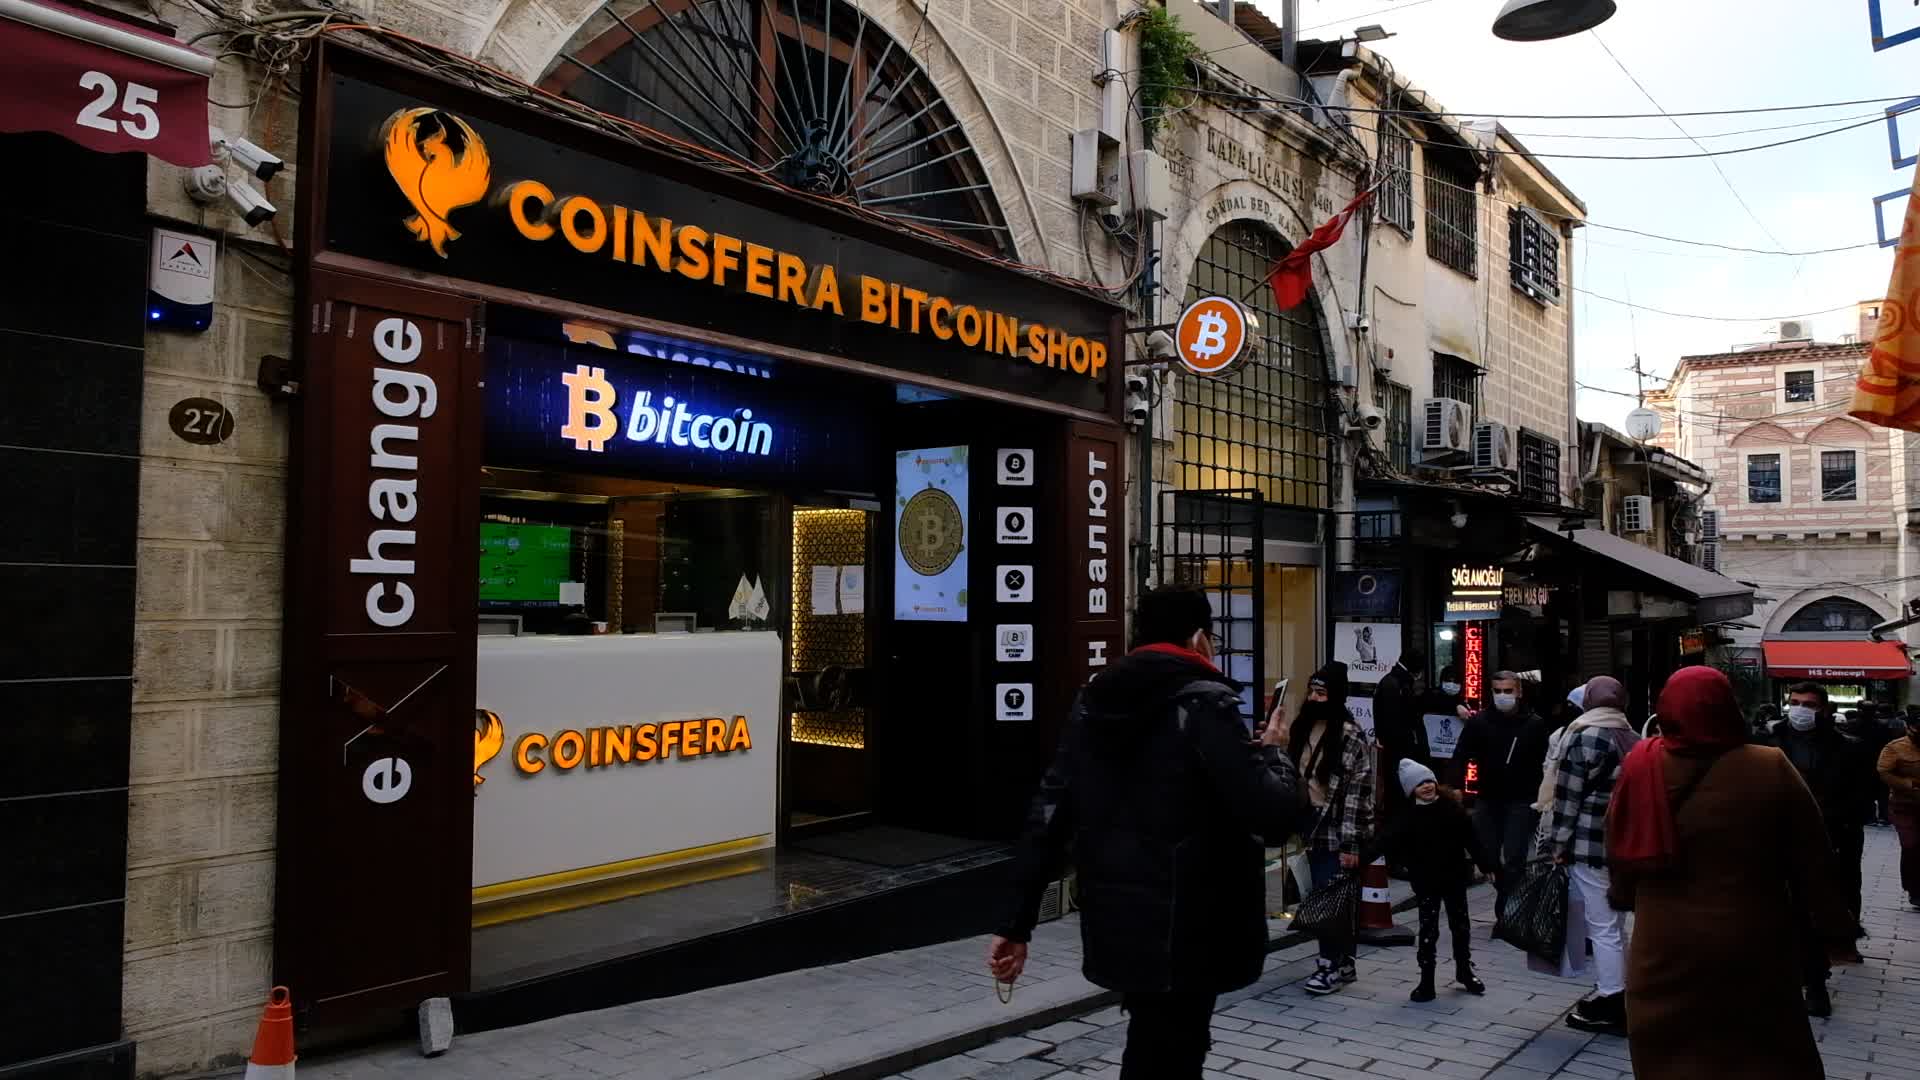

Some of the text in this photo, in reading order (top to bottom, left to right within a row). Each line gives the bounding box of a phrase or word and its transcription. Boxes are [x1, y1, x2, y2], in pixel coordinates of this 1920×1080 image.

[75, 70, 160, 140] 25
[509, 181, 1108, 378] COINSFERA BITCOIN SHOP
[182, 407, 222, 434] 27
[626, 389, 774, 457] bitcoin
[1466, 628, 1479, 698] CHANGE
[517, 716, 751, 774] COINSFERA
